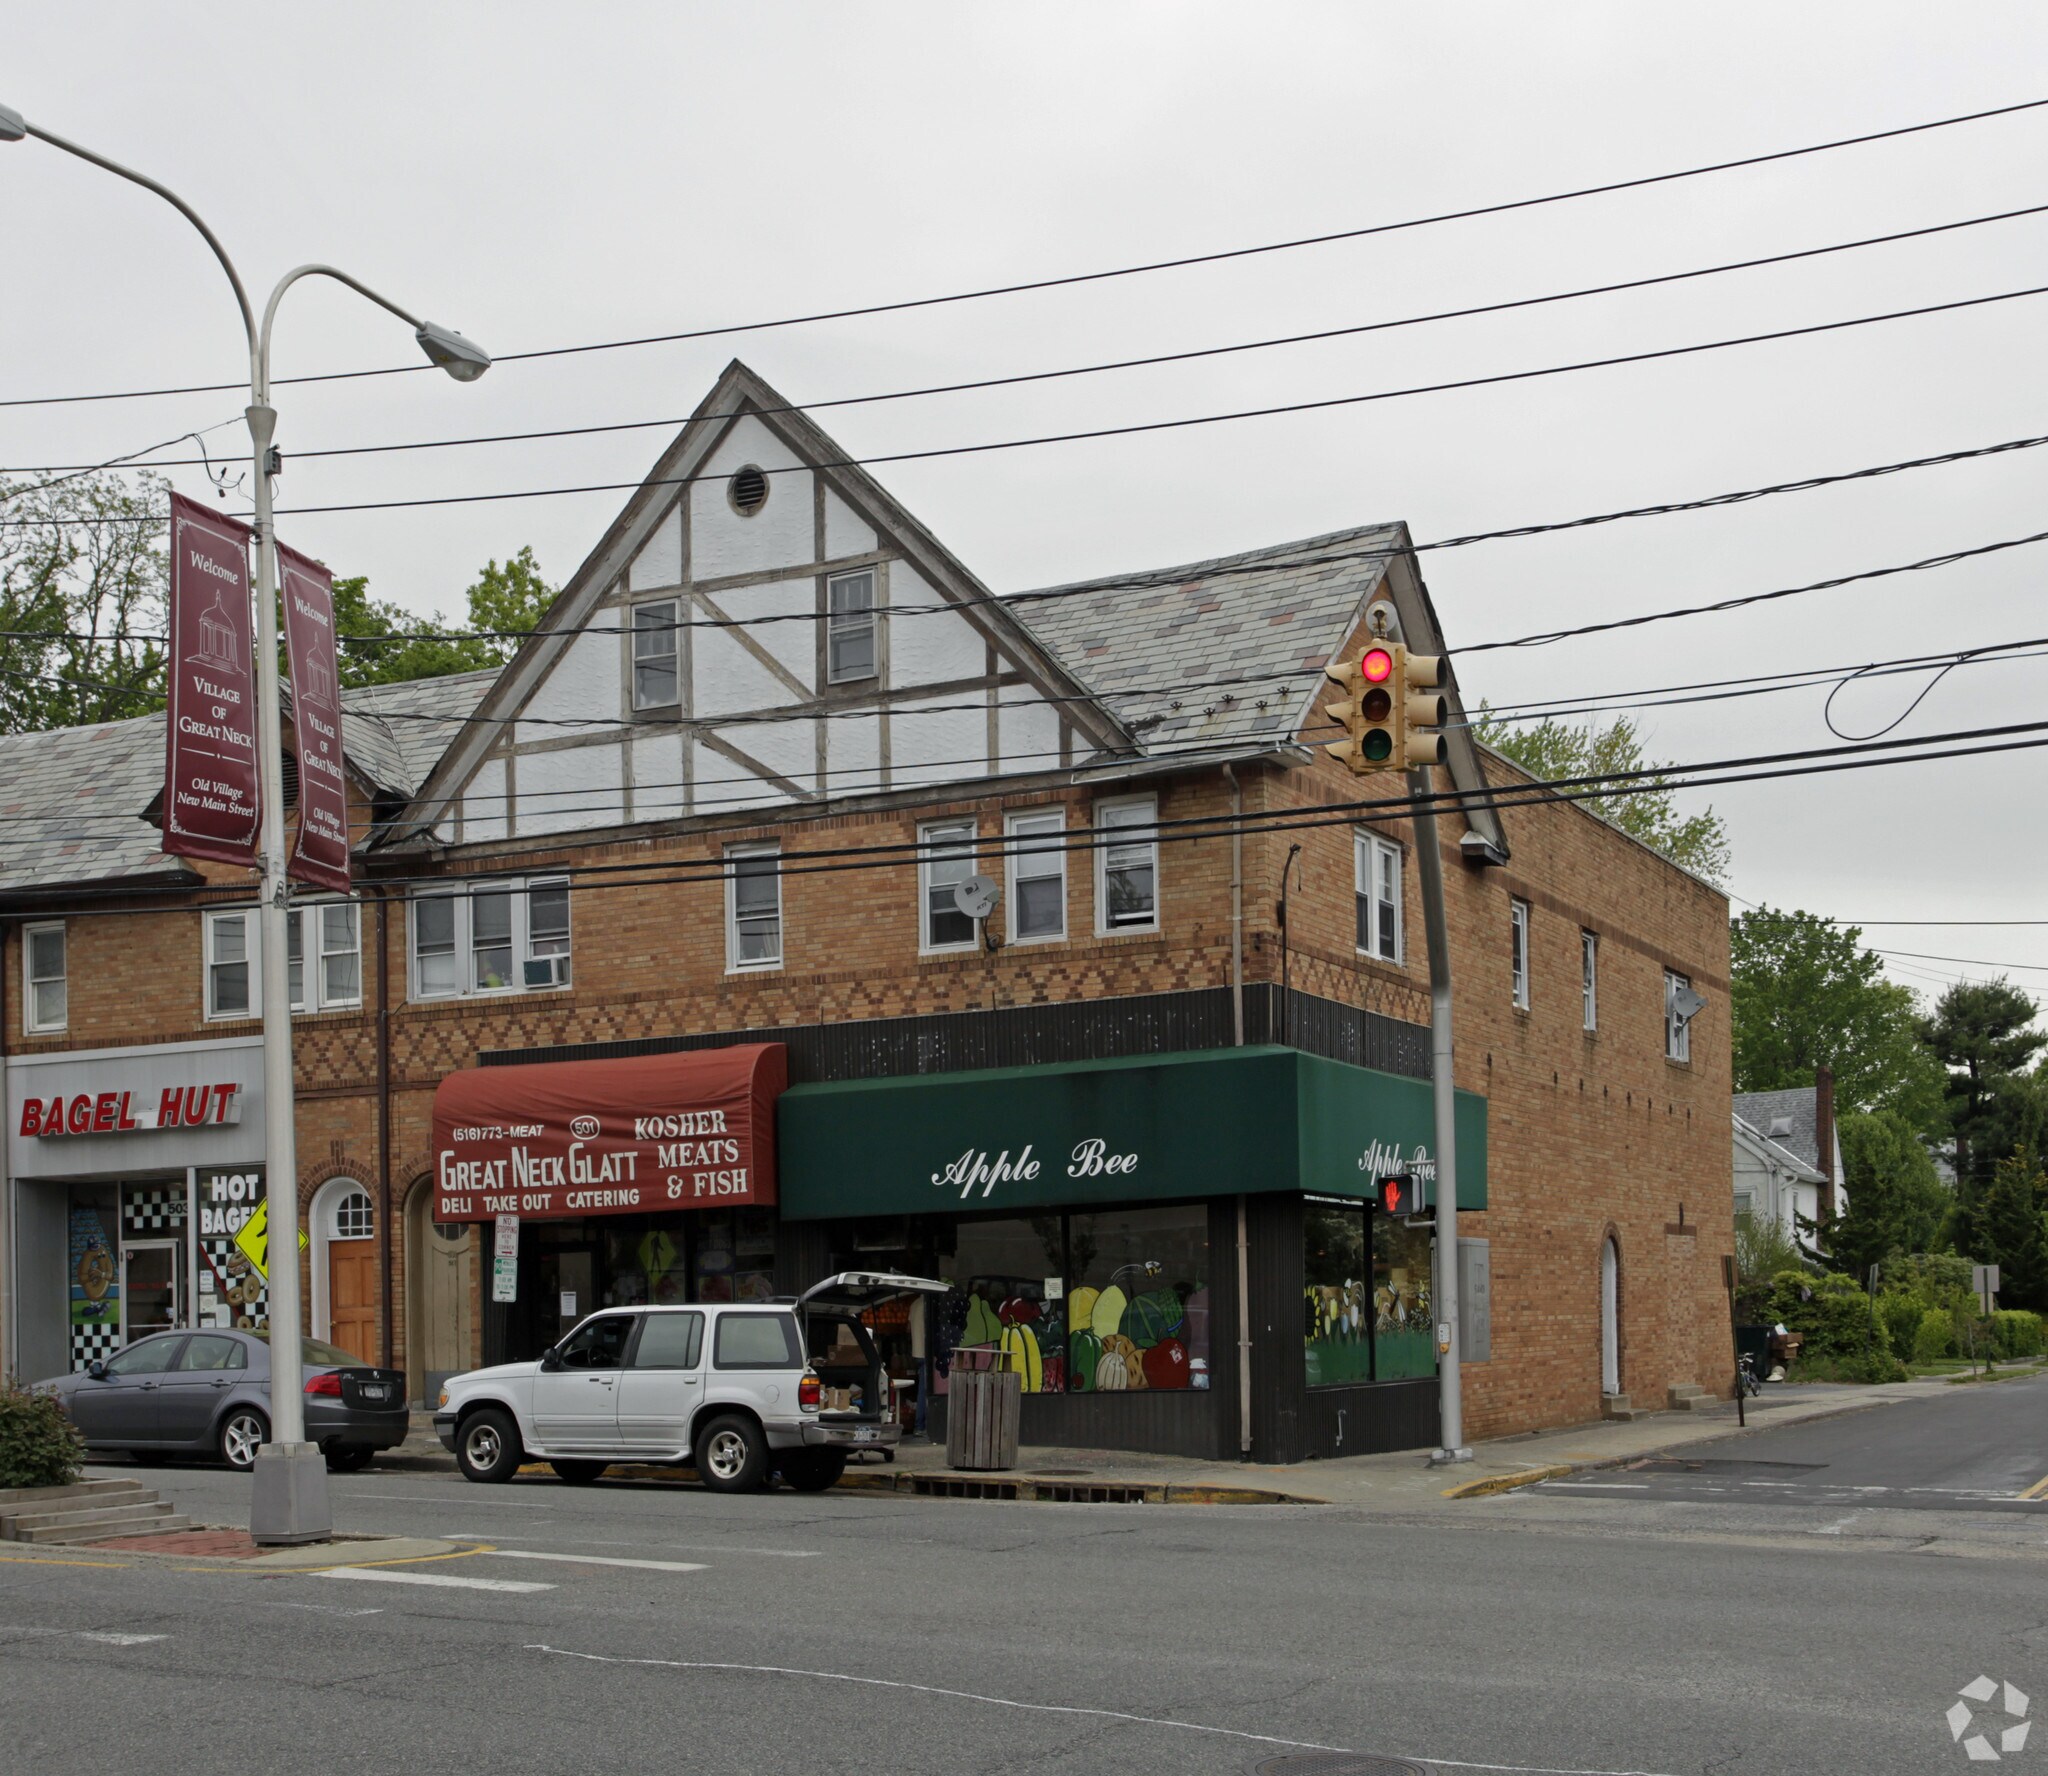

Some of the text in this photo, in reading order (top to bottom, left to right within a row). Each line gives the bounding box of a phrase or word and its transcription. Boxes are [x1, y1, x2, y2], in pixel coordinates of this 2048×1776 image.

[190, 550, 239, 585] Welcome
[294, 595, 329, 627] Welcome
[193, 676, 241, 704] VILLAGE
[211, 706, 227, 720] OF
[308, 712, 335, 739] VILLAGE
[179, 716, 253, 748] GREAT NECK
[320, 740, 329, 754] OF
[304, 749, 342, 780] GREAT NECK
[191, 778, 244, 801] Old Village
[177, 792, 255, 817] New Main Street
[313, 807, 341, 830] Old Village
[305, 819, 319, 834] New
[19, 1083, 237, 1137] BAGEL HUT
[453, 1124, 544, 1141] (516)773-MEAT
[574, 1121, 595, 1135] 501
[634, 1109, 728, 1140] KOSHER
[440, 1142, 638, 1191] GREAT NECK GLATT
[657, 1138, 739, 1169] MEATS
[1358, 1138, 1403, 1187] Apple
[931, 1137, 1139, 1199] Apple Bee
[211, 1174, 259, 1202] HOT
[666, 1168, 748, 1199] & FISH
[441, 1188, 640, 1214] DELI TAKE OUT CATERING
[502, 1217, 512, 1226] NO
